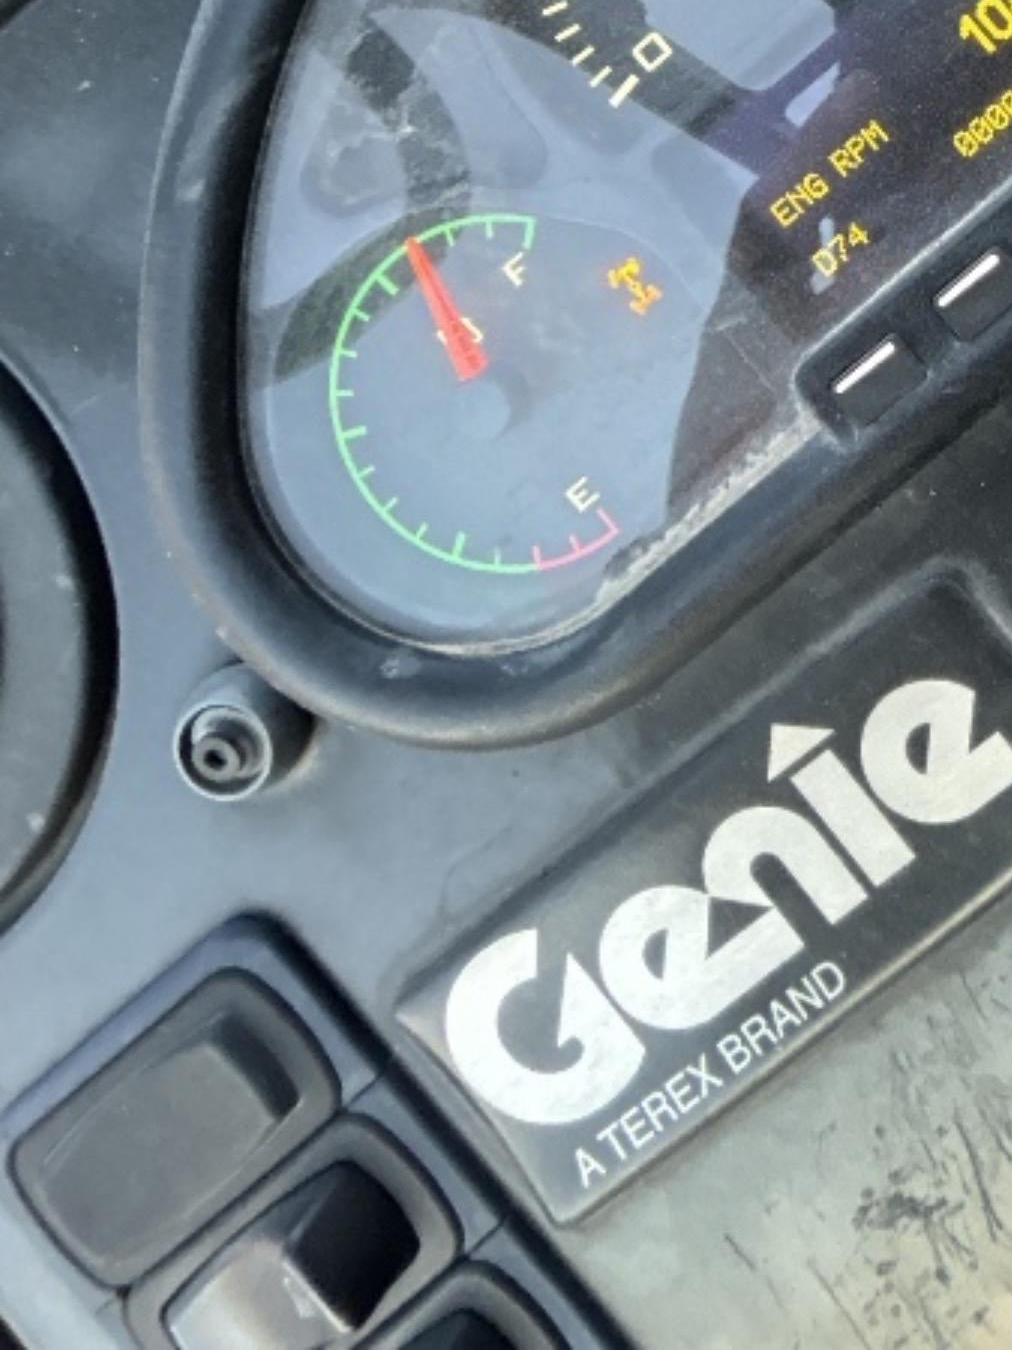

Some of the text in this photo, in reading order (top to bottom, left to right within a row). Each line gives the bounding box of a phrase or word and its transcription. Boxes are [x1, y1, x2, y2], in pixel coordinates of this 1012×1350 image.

[632, 32, 673, 72] 0
[769, 119, 890, 229] ENG RPM
[502, 252, 527, 288] F
[564, 476, 601, 514] E
[574, 960, 848, 1188] A TEREX BRAND
